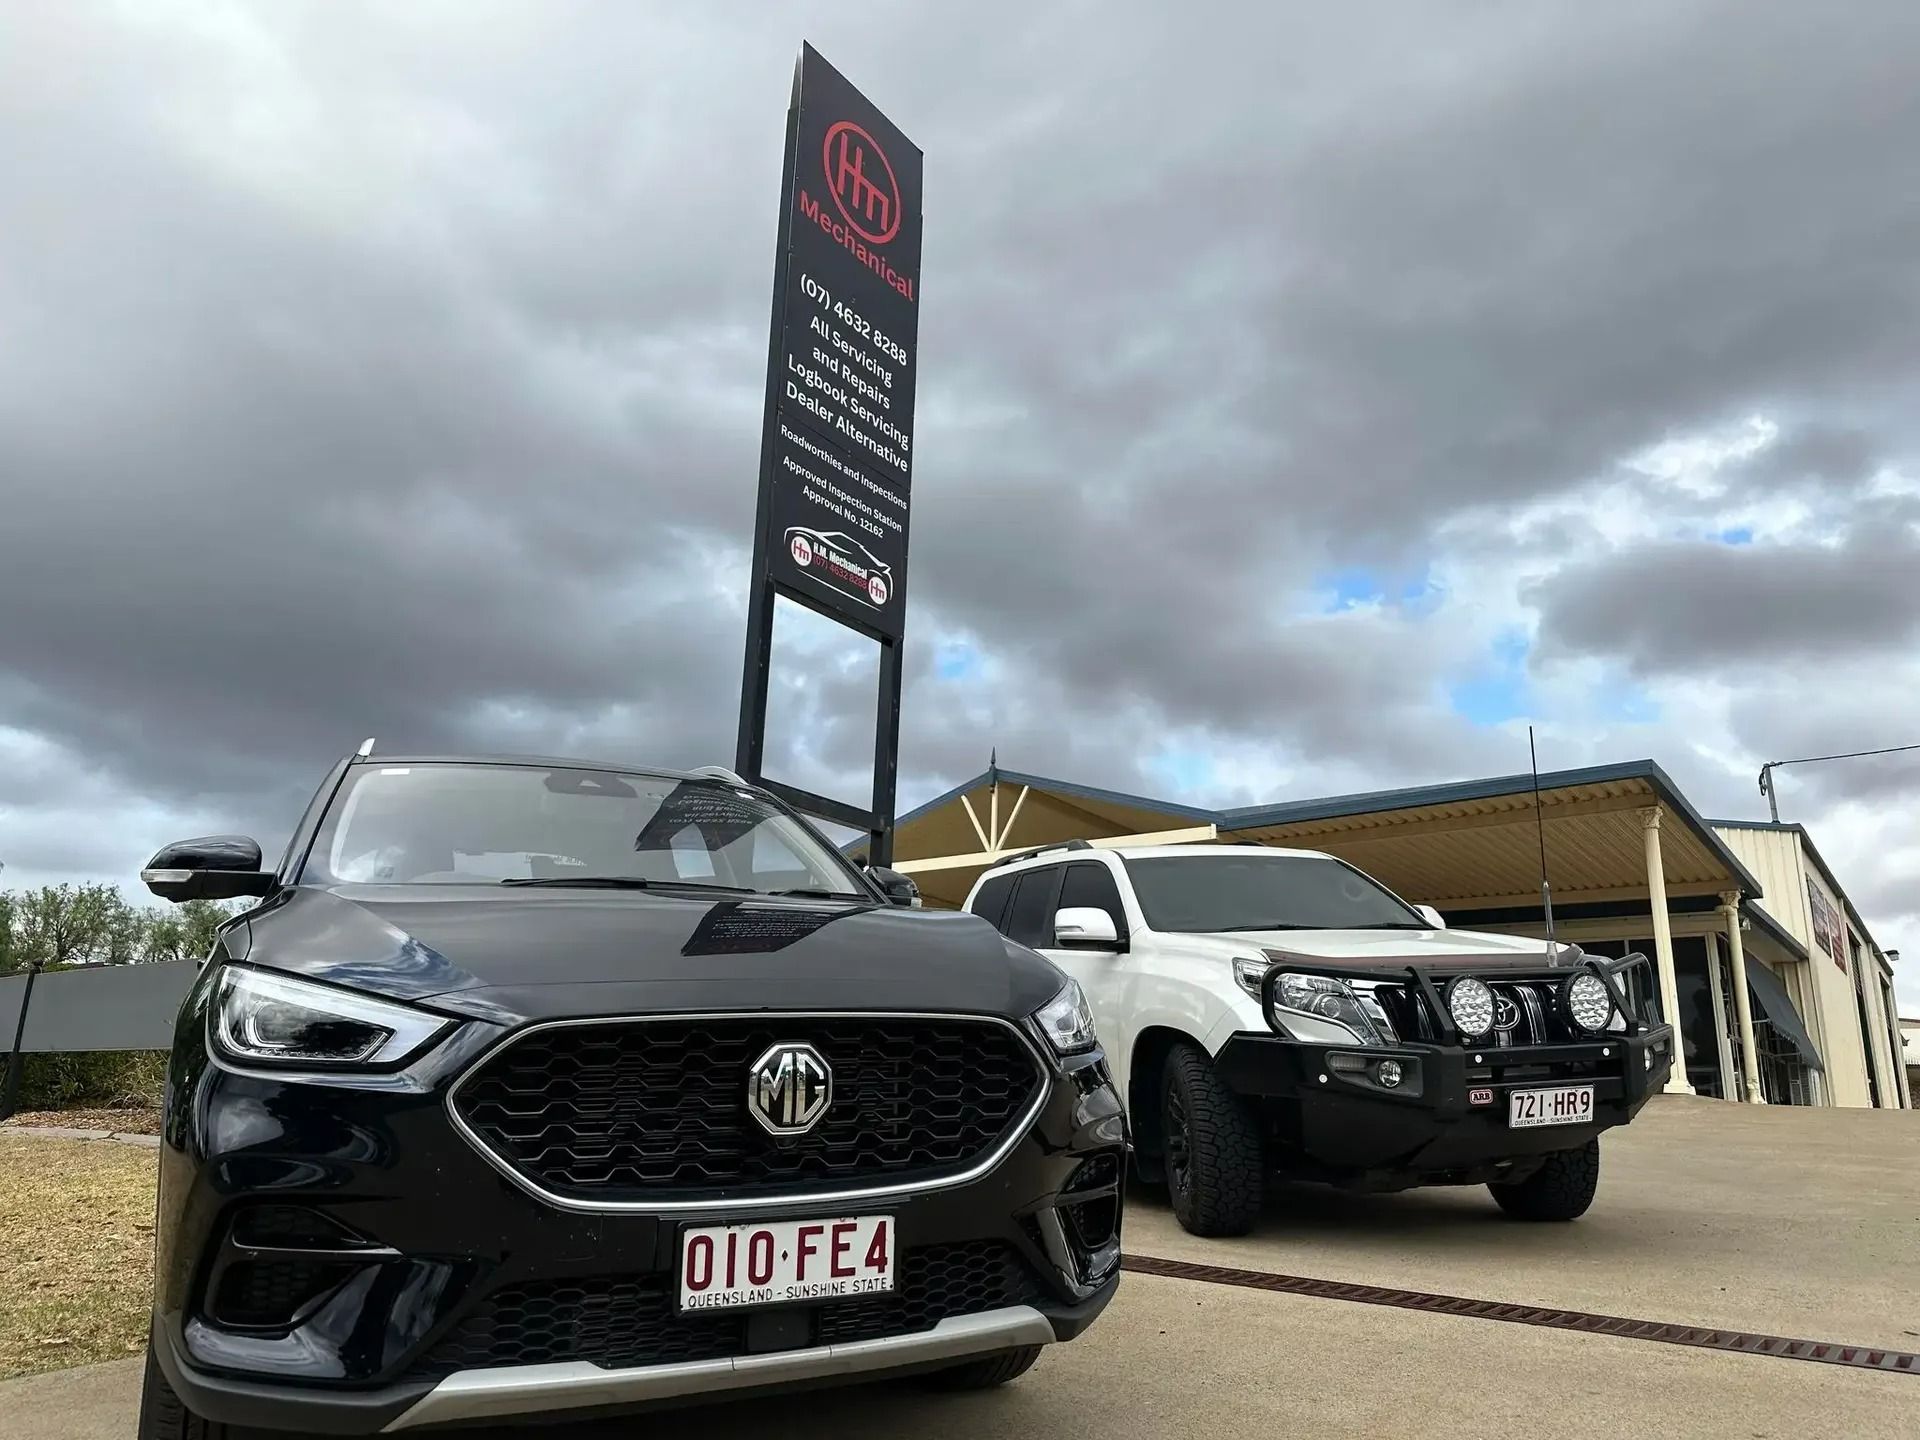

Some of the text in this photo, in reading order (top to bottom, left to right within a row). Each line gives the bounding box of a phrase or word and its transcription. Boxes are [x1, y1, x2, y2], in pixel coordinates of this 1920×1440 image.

[800, 189, 913, 302] Mechanical
[800, 273, 908, 366] (07) 4632 8288
[810, 315, 893, 389] All Servicing
[788, 353, 909, 451] Logbook Servicing
[812, 346, 891, 409] and Repairs
[786, 380, 909, 472] Dealer Alternative
[780, 424, 908, 510] Roadworthies and Inspections
[783, 455, 902, 533] Approved Inspection Station
[802, 485, 884, 538] Approval No. 12162
[829, 550, 868, 580] Mechanical
[829, 564, 848, 580] 4632
[760, 1052, 826, 1125] MG
[1472, 1092, 1490, 1101] ARB
[1514, 1118, 1546, 1126] QUEENSLAND
[1550, 1116, 1574, 1124] SUNSHINE
[688, 1286, 773, 1308] QUEENSLAND
[786, 1281, 846, 1299] SUNSHINE
[852, 1277, 887, 1292] STATE
